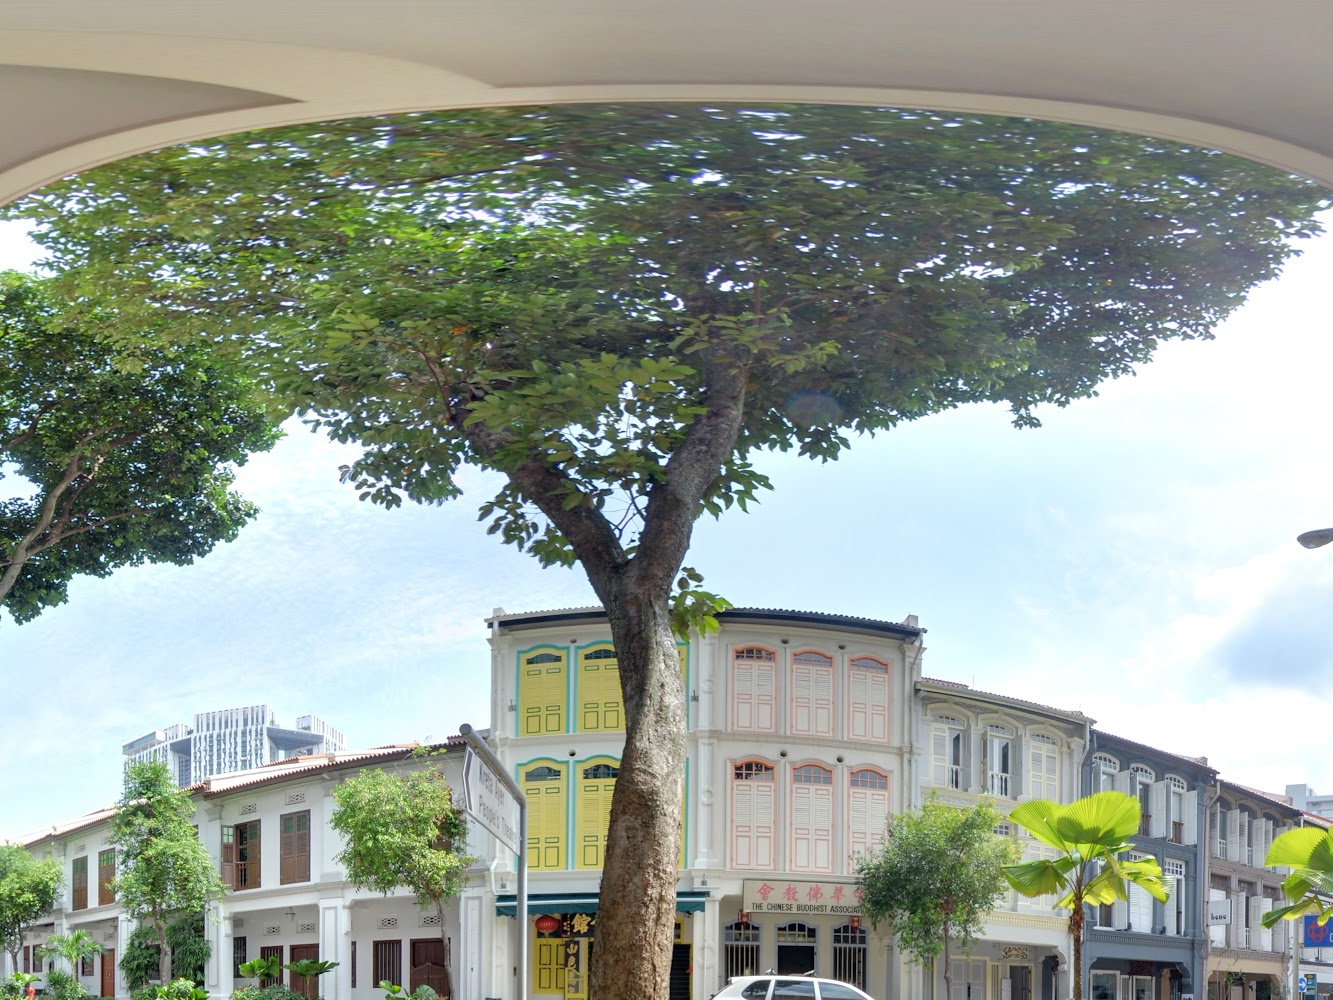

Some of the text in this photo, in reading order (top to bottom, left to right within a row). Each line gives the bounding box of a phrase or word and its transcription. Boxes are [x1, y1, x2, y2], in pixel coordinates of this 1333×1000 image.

[752, 902, 764, 911] THE
[766, 903, 794, 912] CHINESE
[796, 904, 828, 913] BUDDHIST
